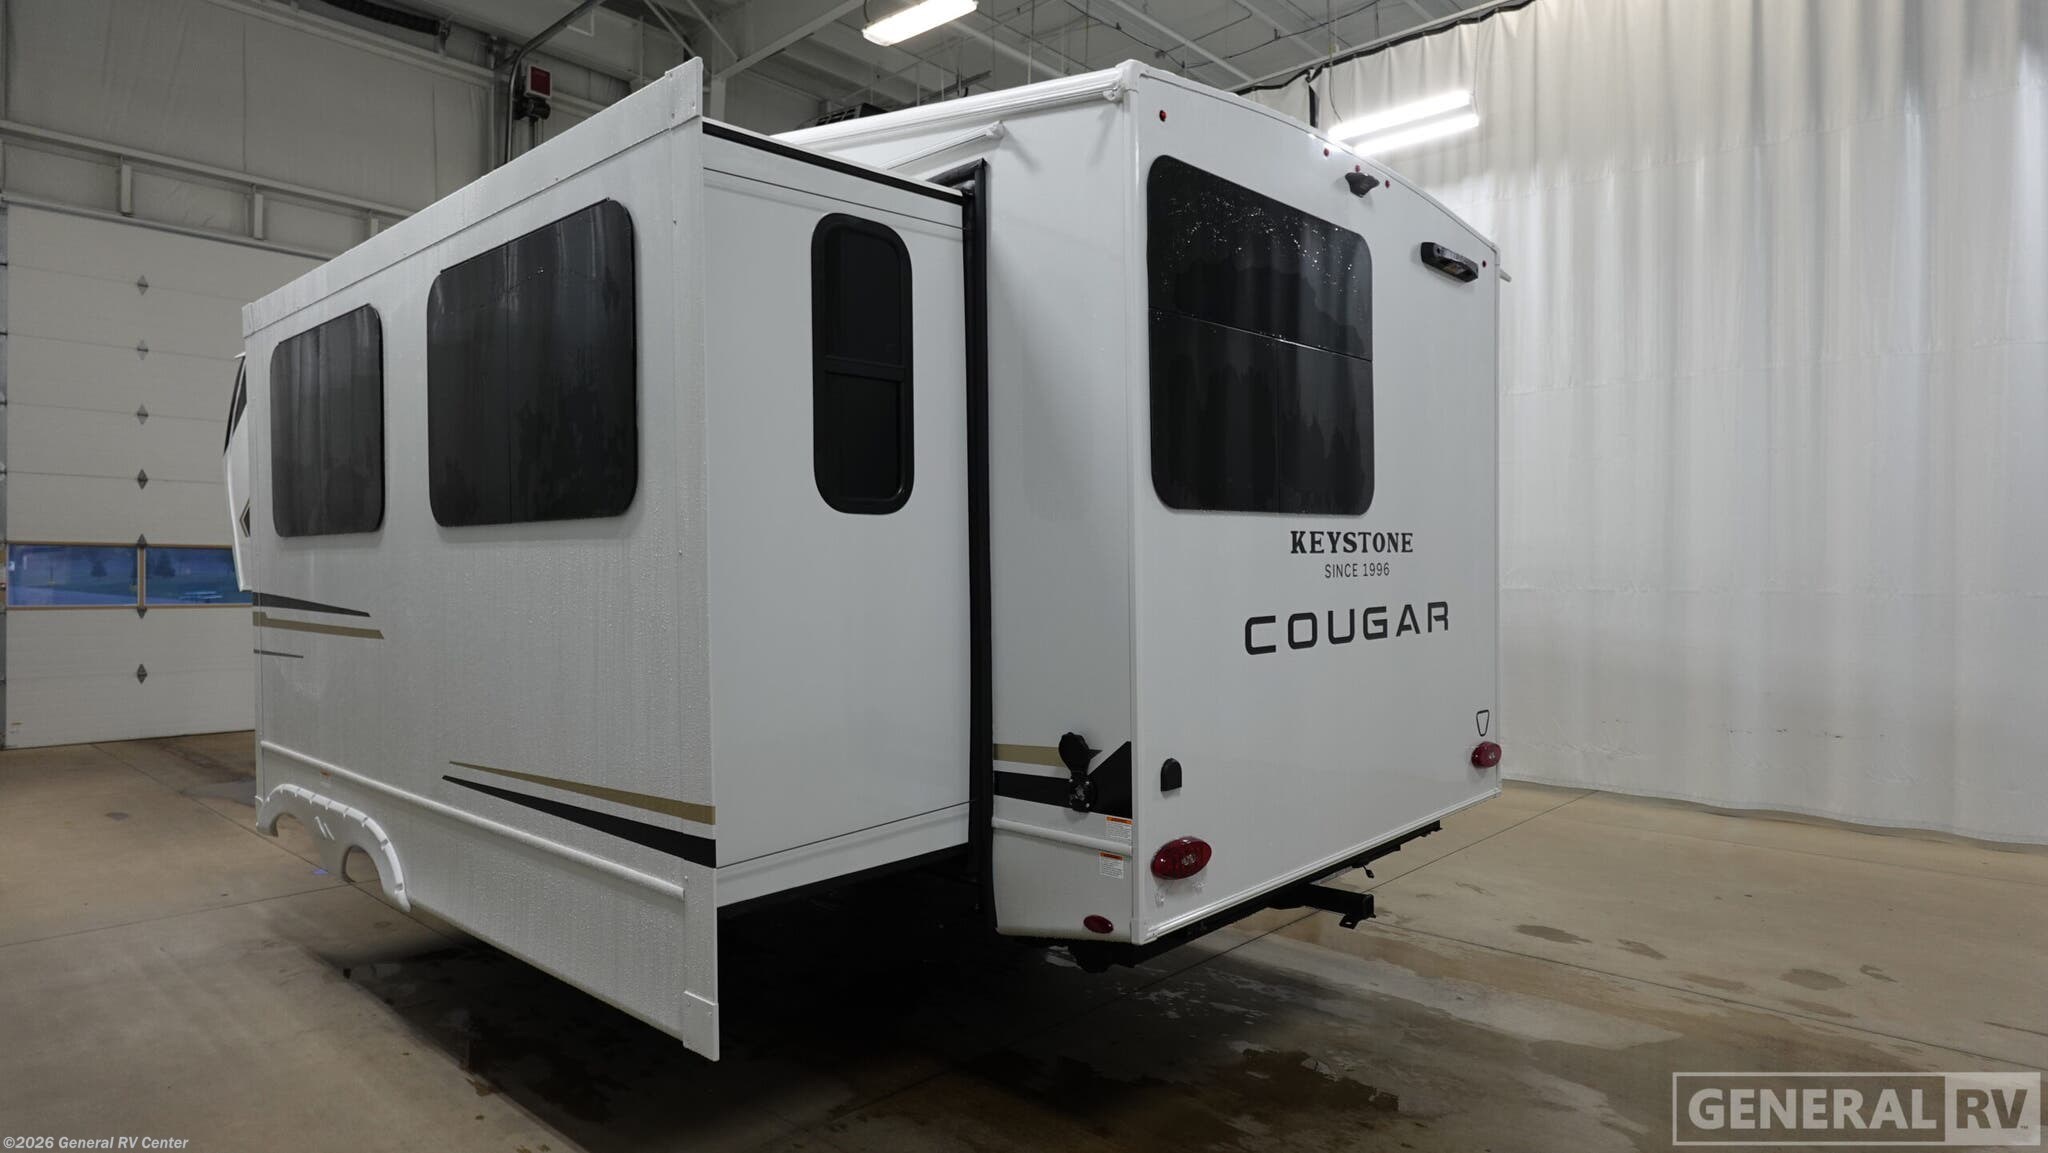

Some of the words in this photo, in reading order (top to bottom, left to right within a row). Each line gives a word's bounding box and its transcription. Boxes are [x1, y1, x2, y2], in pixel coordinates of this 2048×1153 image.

[1290, 530, 1414, 555] KEYSTONE
[1324, 562, 1359, 579] SINCE
[1363, 561, 1391, 577] 1996
[1244, 600, 1450, 656] COUGAR
